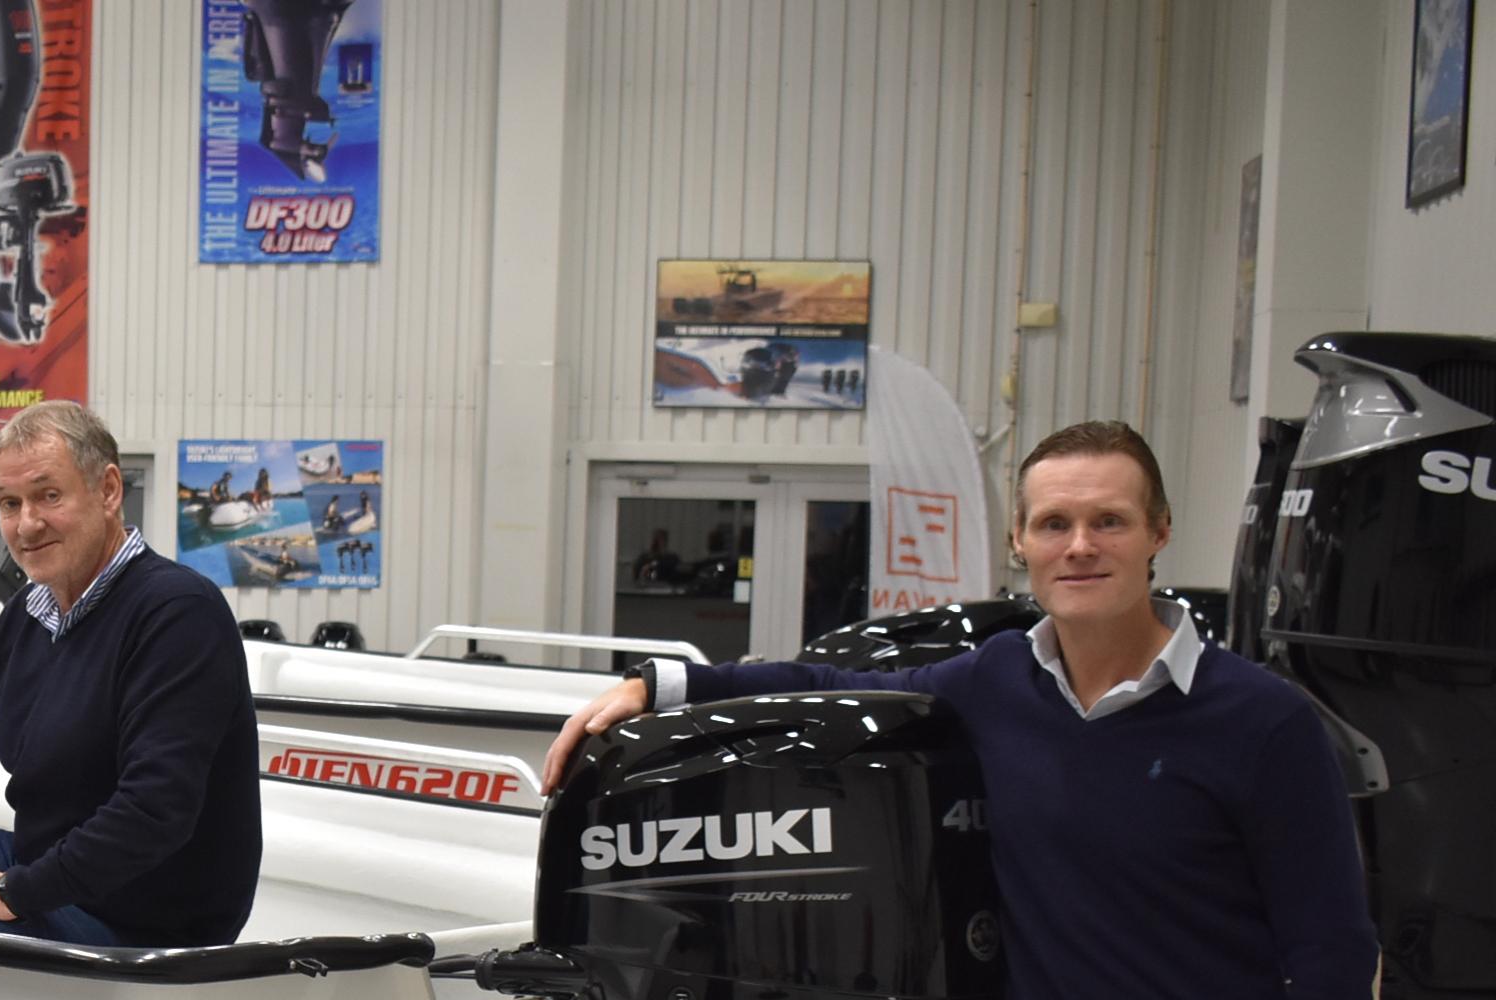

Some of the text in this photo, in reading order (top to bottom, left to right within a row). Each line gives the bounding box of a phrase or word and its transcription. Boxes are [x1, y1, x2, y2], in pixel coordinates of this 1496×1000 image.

[207, 68, 240, 93] IN
[206, 100, 240, 204] ULTIMATE
[205, 211, 238, 251] THE
[245, 195, 355, 231] DF300
[260, 230, 292, 253] 4.0
[291, 230, 339, 253] Liter
[580, 807, 833, 870] SUZUKI
